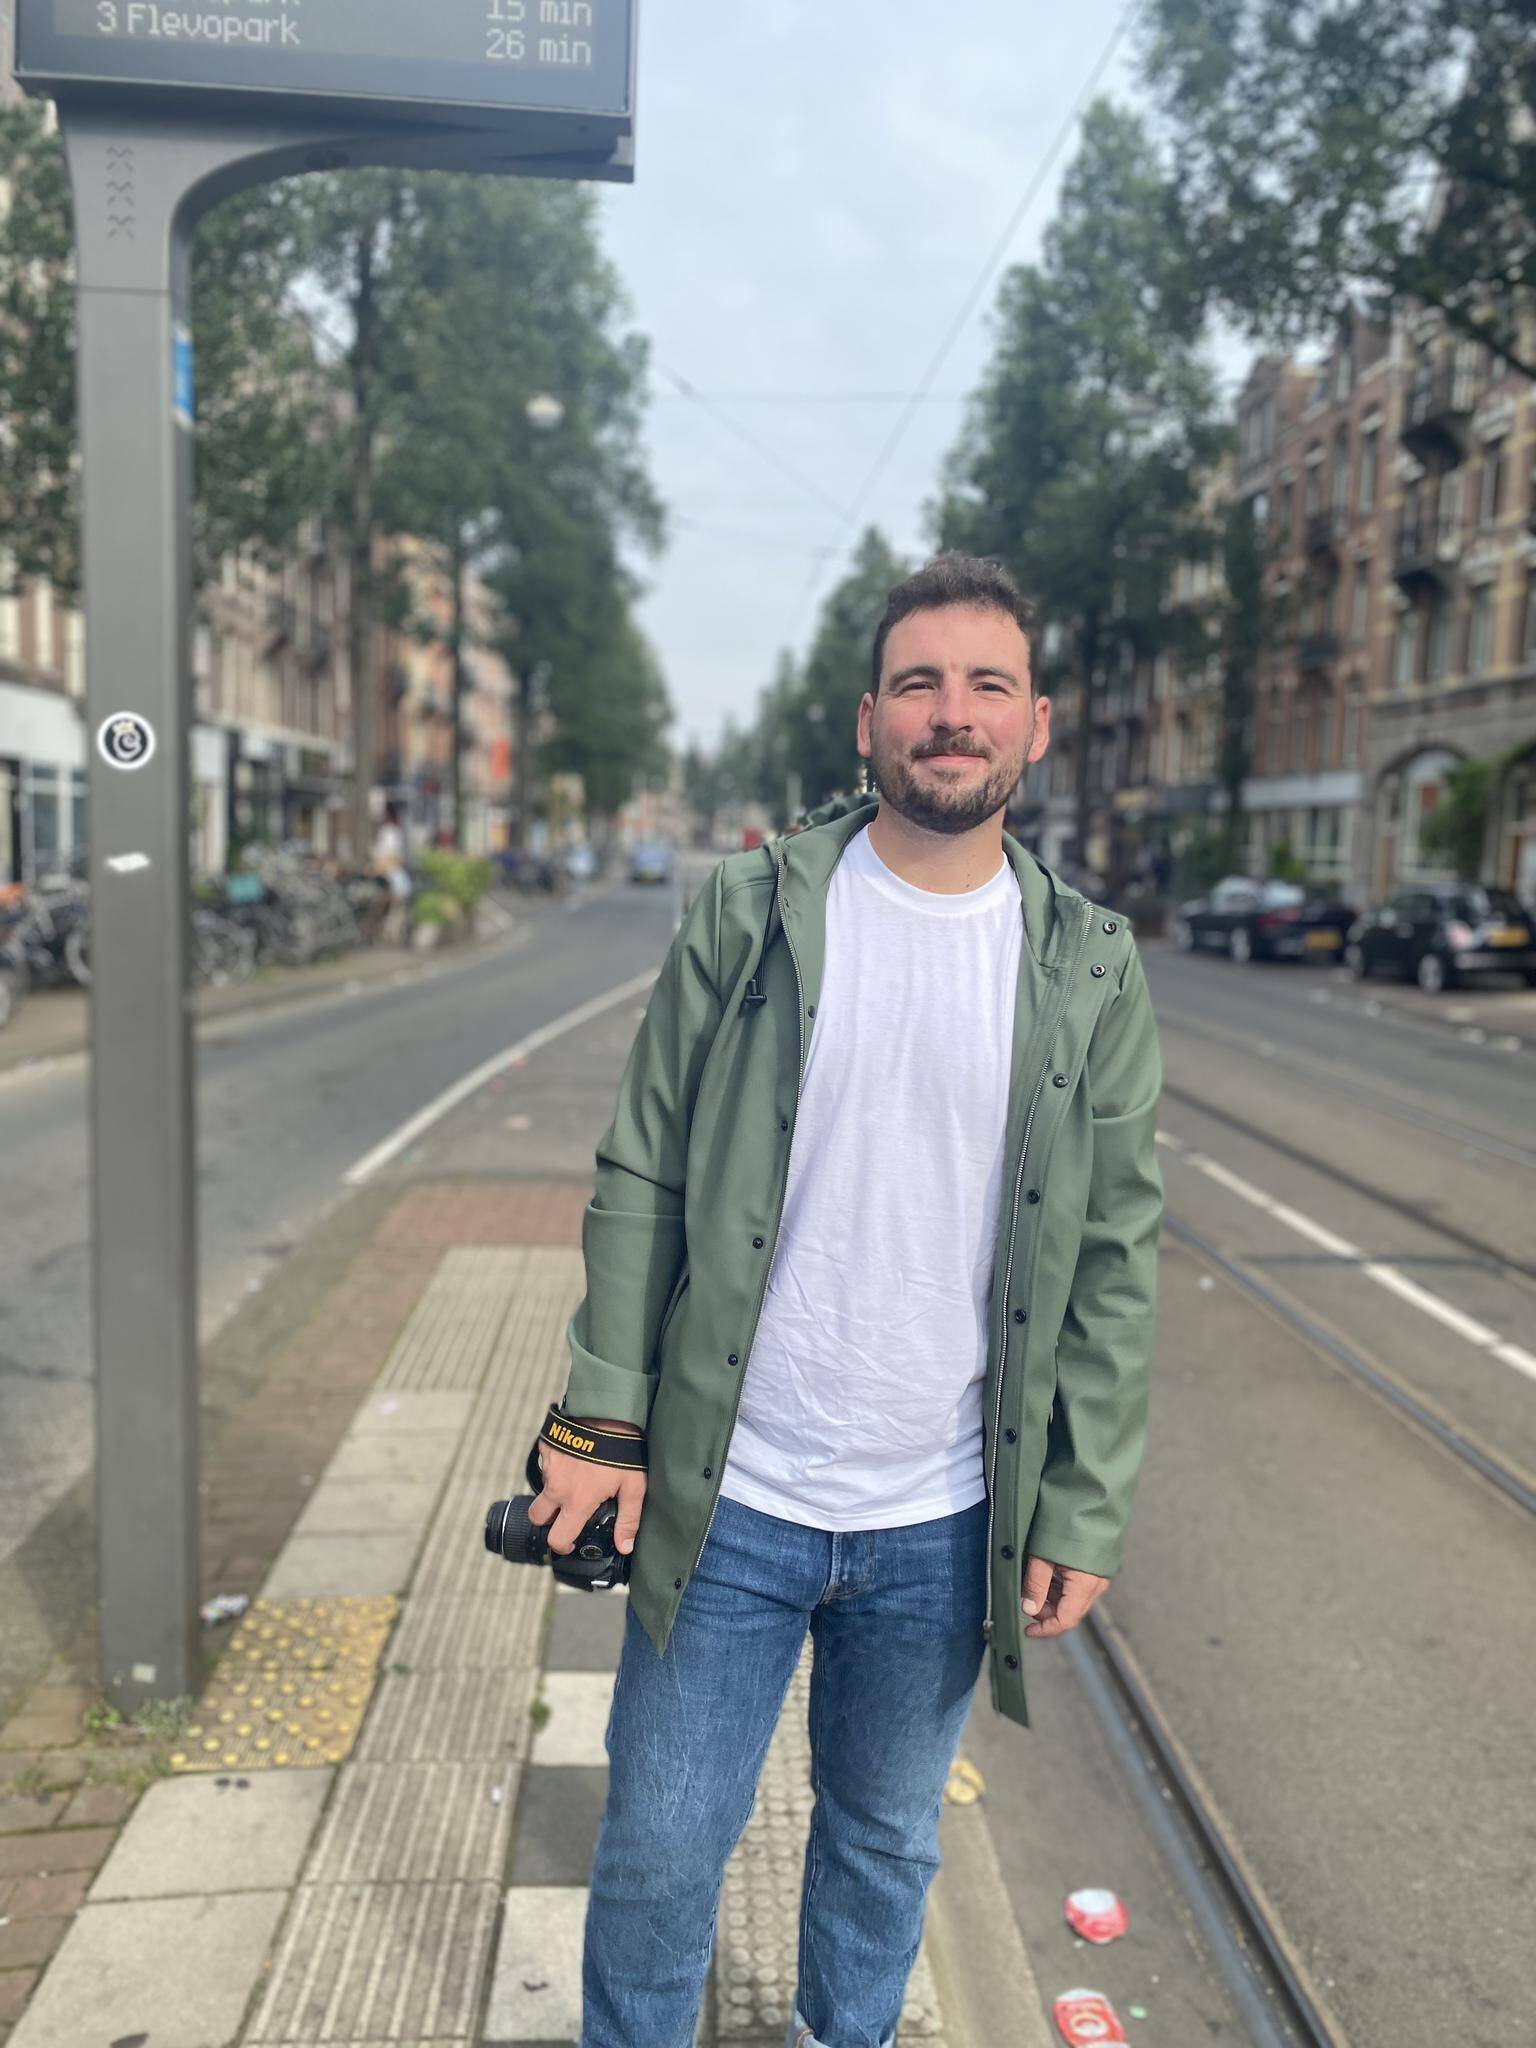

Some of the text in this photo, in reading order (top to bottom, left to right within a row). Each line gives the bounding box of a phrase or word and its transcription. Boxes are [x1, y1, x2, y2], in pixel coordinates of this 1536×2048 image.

[96, 1, 300, 45] 3 Flevopark
[486, 28, 592, 65] 26 min
[549, 1422, 595, 1453] Nikon
